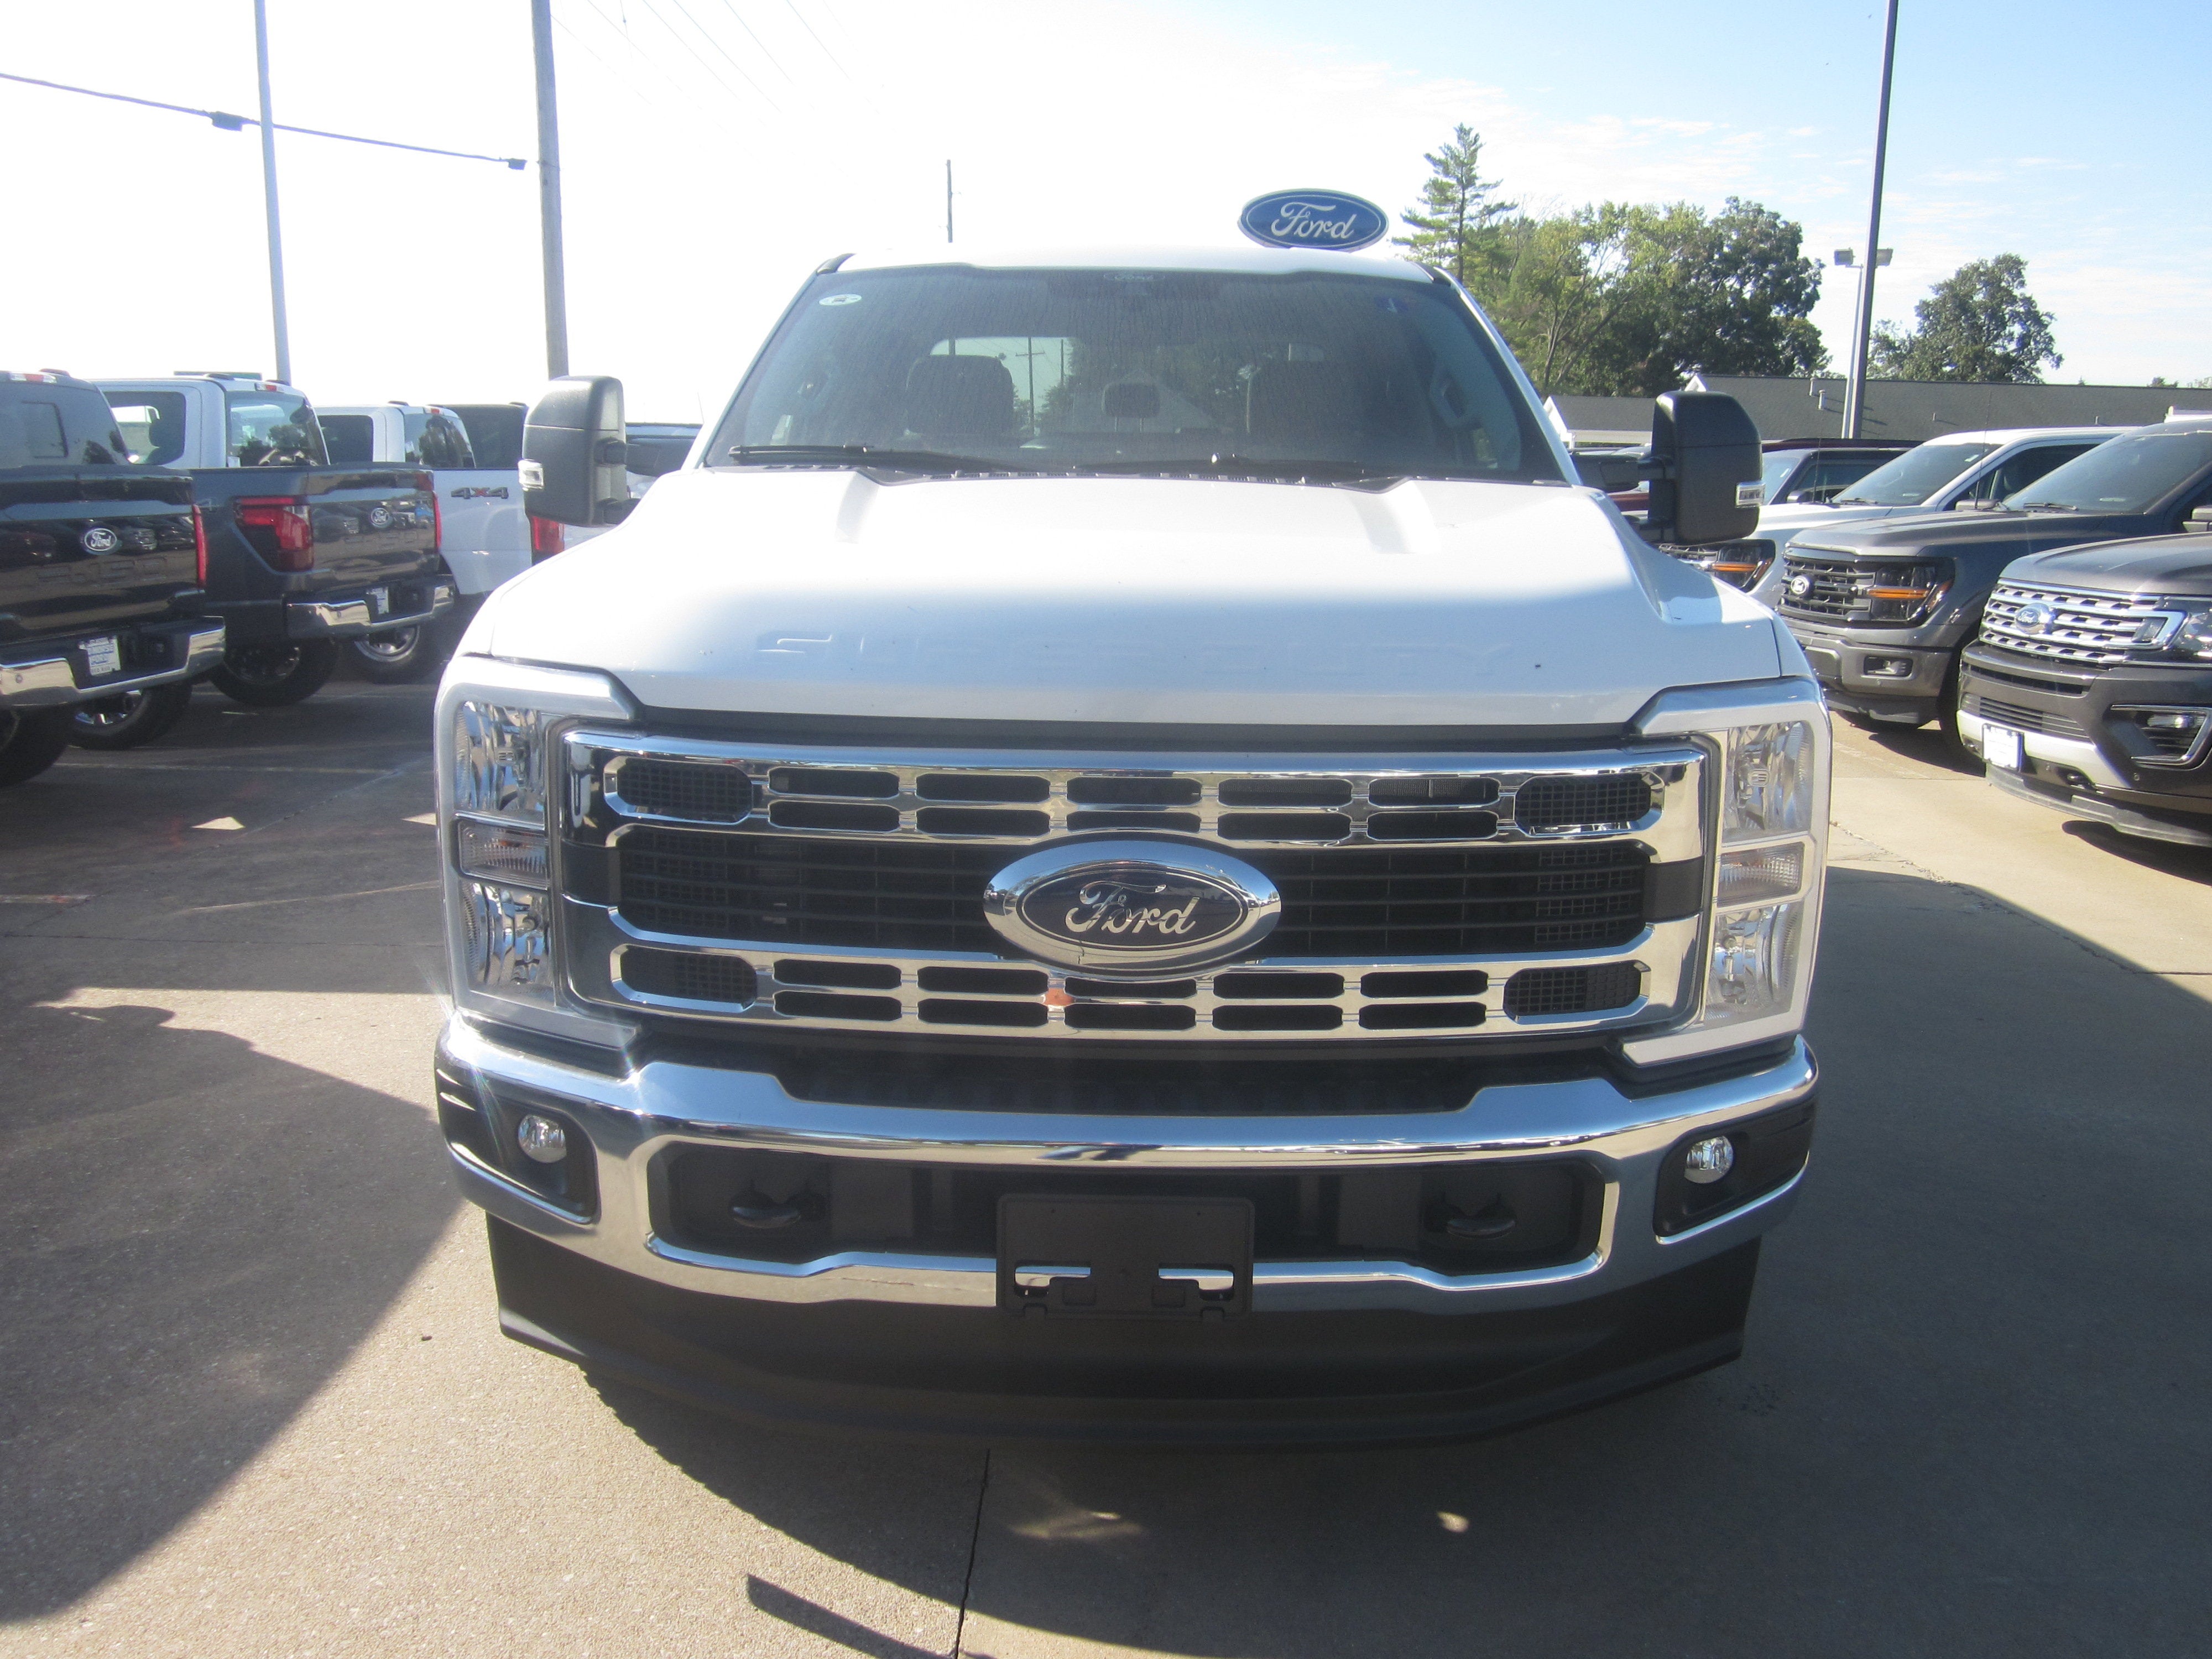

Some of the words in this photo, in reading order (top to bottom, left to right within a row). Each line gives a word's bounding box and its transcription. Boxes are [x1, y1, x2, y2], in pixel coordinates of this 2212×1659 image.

[1271, 201, 1357, 239] Ford
[91, 531, 111, 547] Ford
[1065, 880, 1200, 934] Ford
